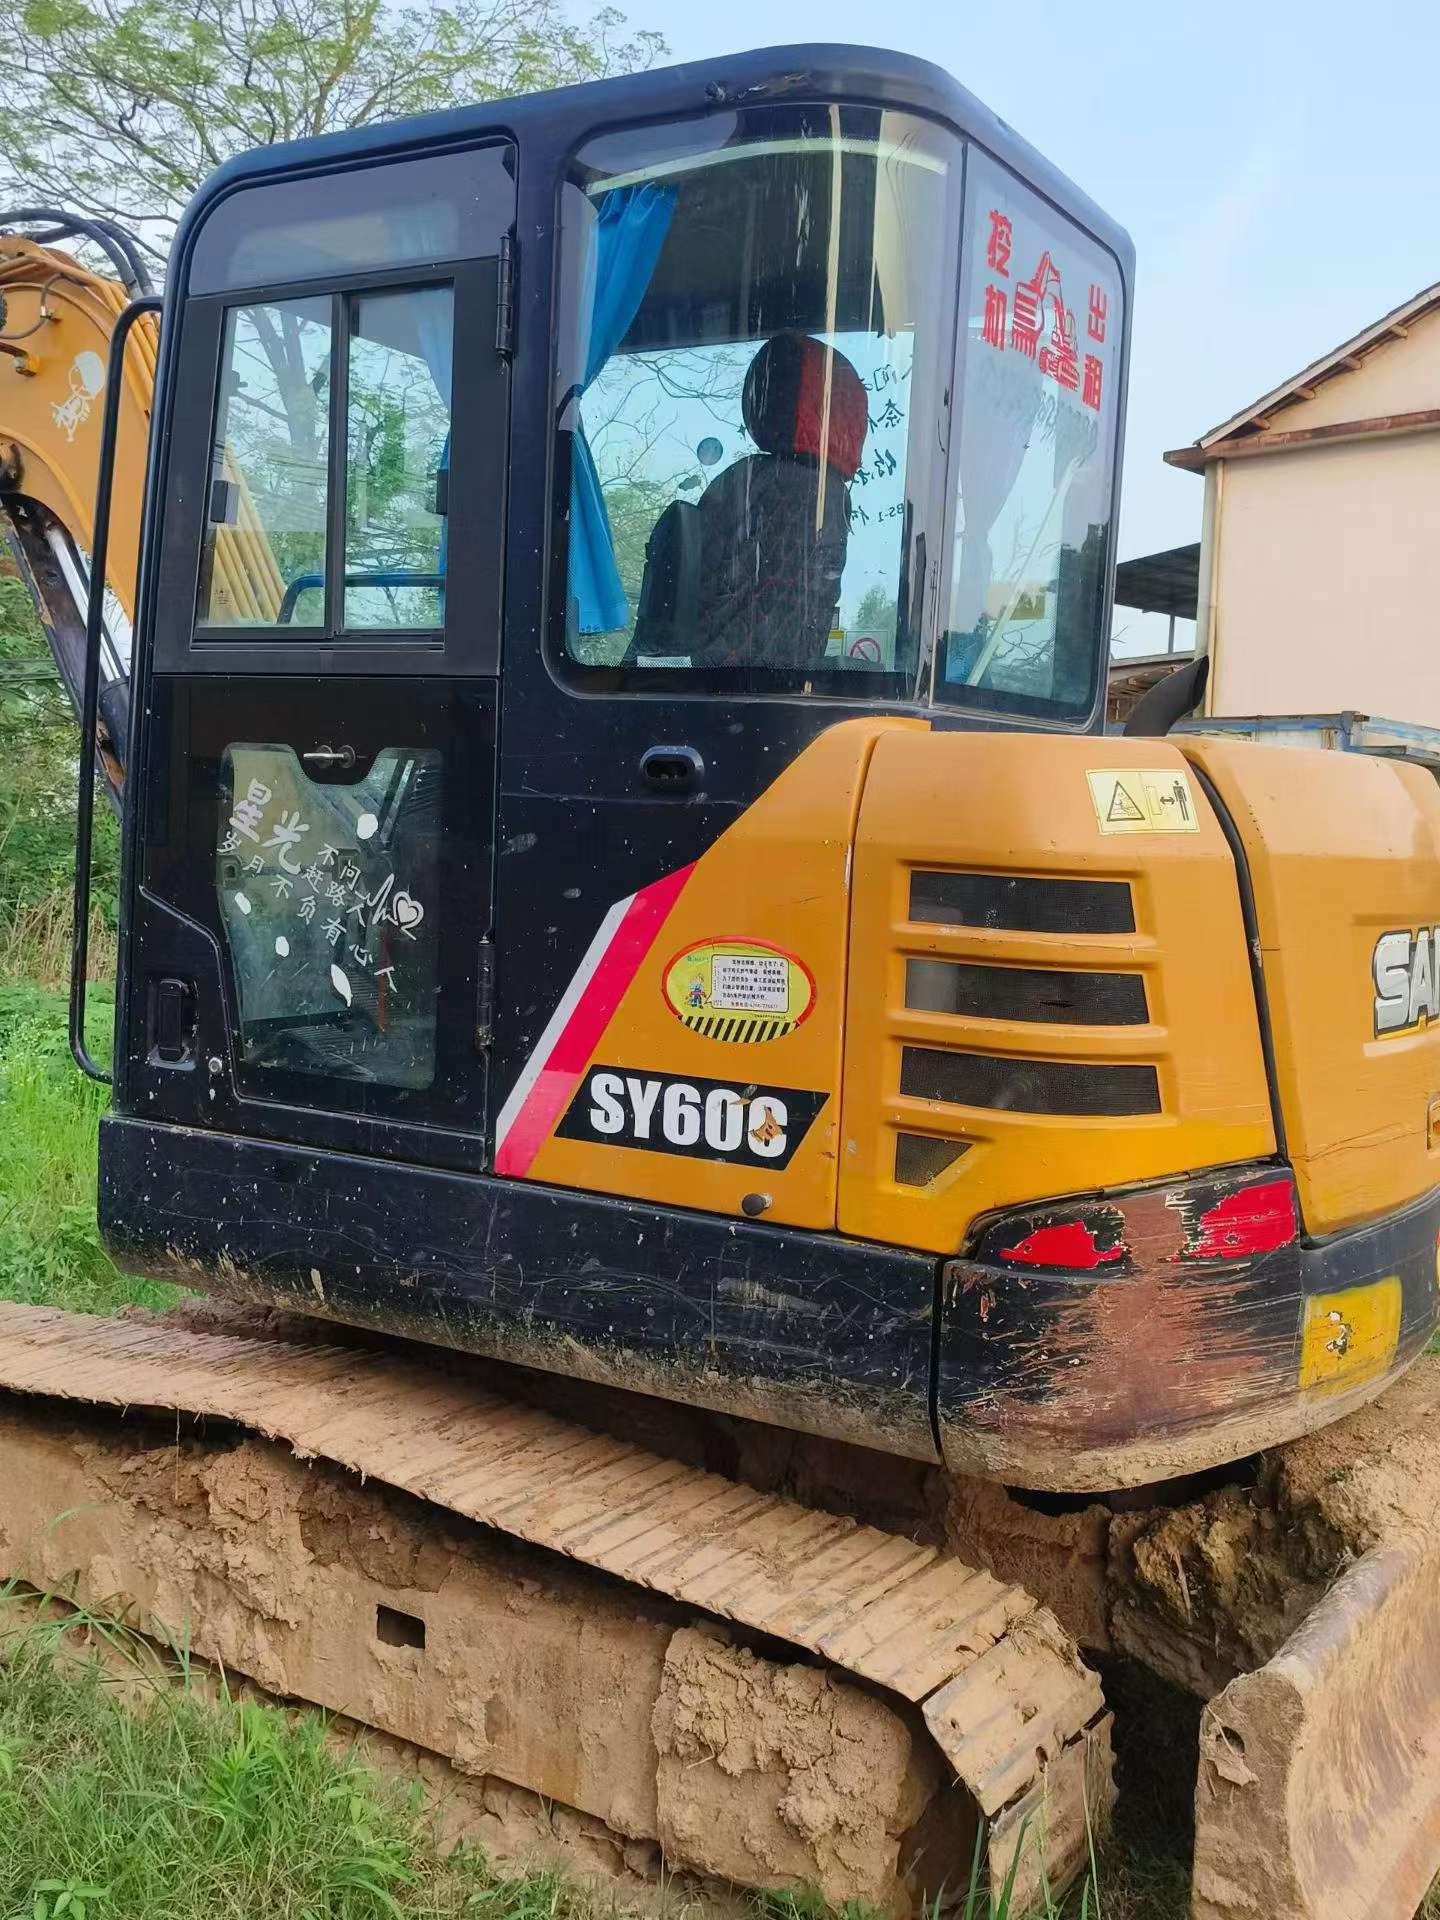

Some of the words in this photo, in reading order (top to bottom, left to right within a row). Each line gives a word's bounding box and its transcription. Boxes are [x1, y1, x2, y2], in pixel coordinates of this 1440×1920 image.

[983, 209, 1012, 352] 挖机
[1082, 284, 1108, 411] 出租
[229, 777, 310, 876] 星光
[317, 842, 361, 892] 不问
[216, 830, 398, 994] 岁月不负有心人
[301, 864, 368, 928] 赶路人
[589, 1072, 789, 1159] SY60C
